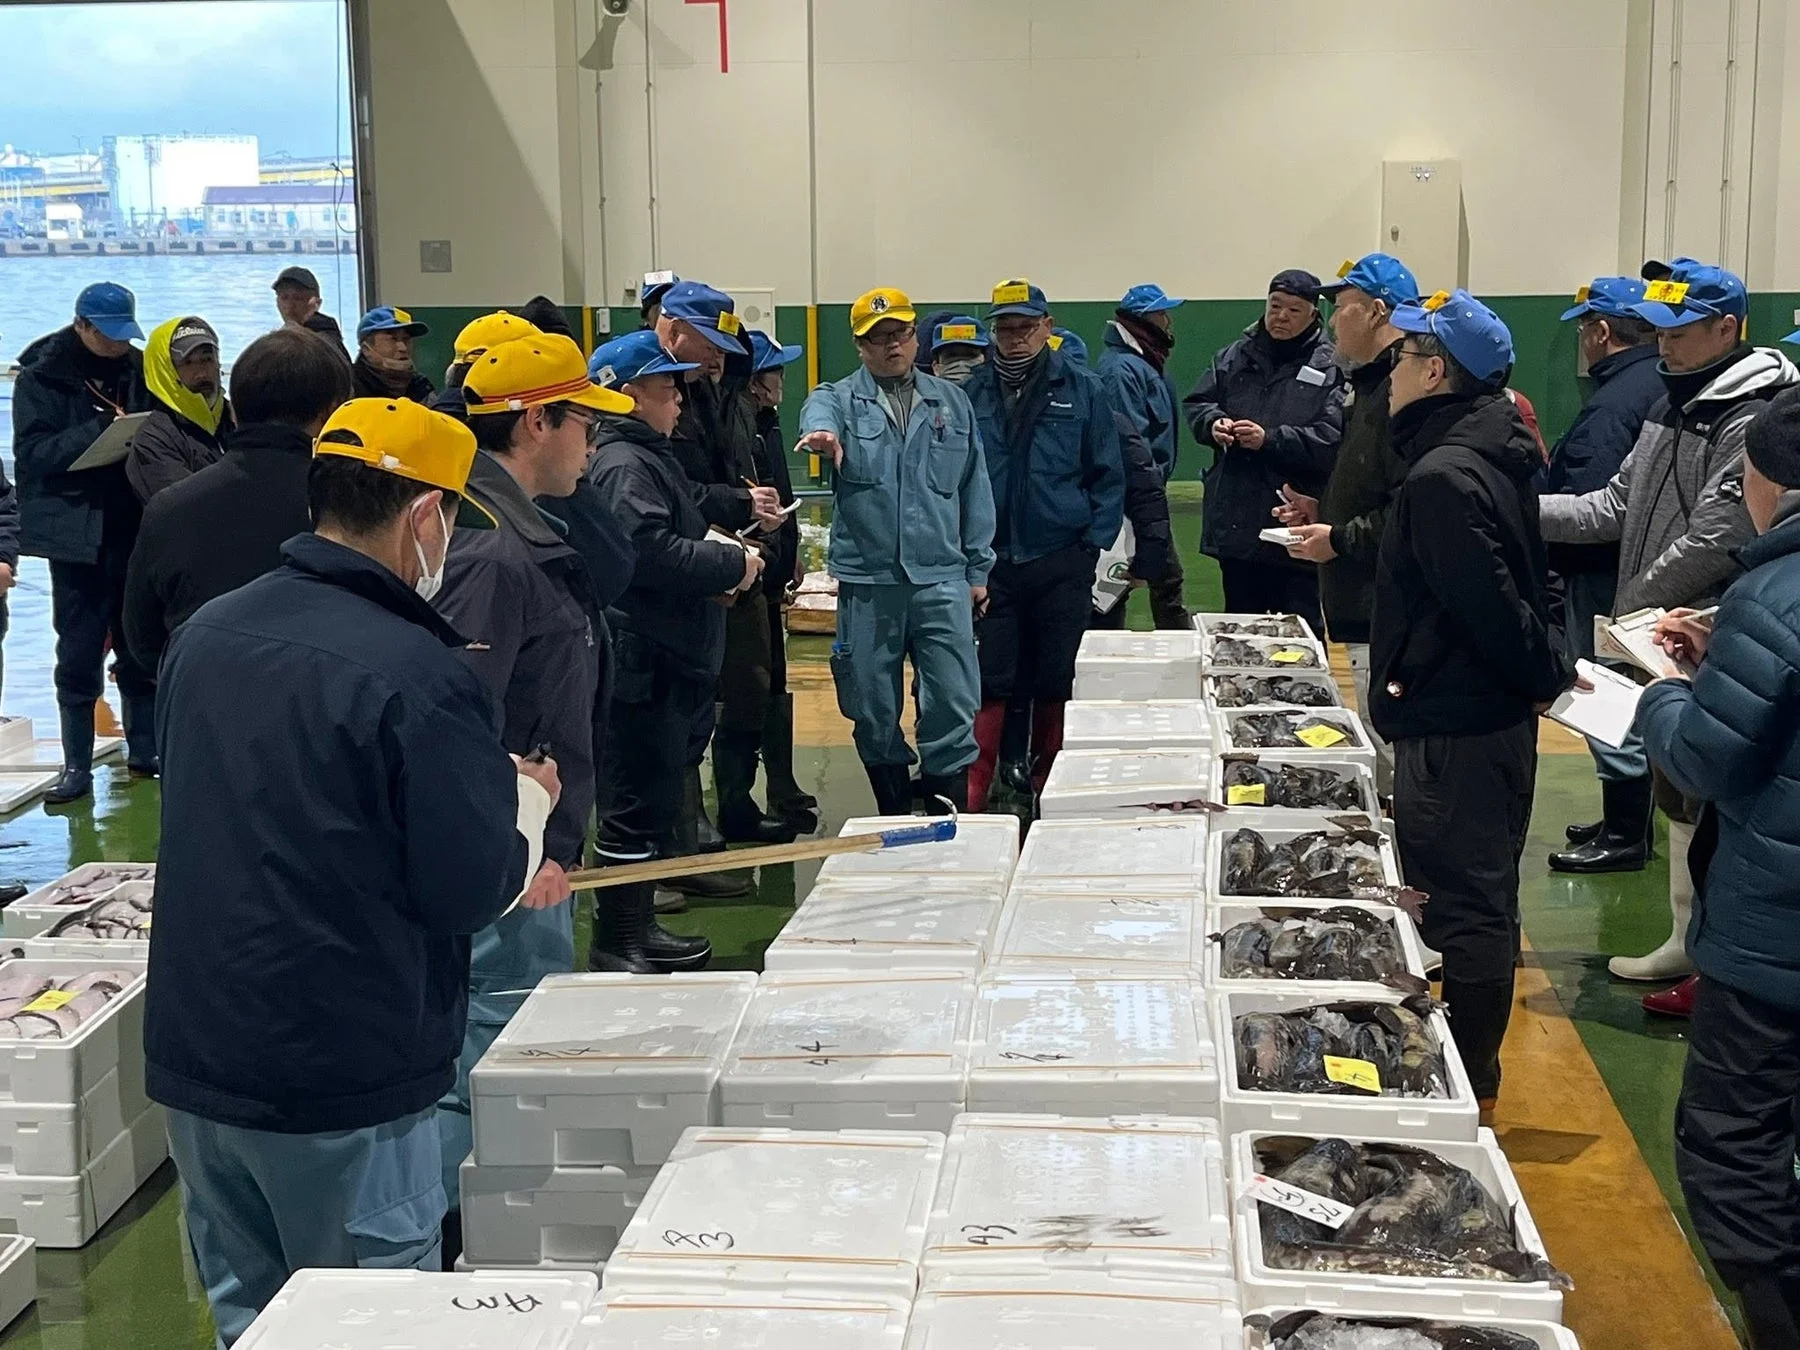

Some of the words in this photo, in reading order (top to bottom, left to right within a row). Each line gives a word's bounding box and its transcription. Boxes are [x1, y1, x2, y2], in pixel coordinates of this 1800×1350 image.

[661, 1229, 735, 1250] A3
[961, 1224, 1018, 1245] A3
[451, 1292, 543, 1313] A3
